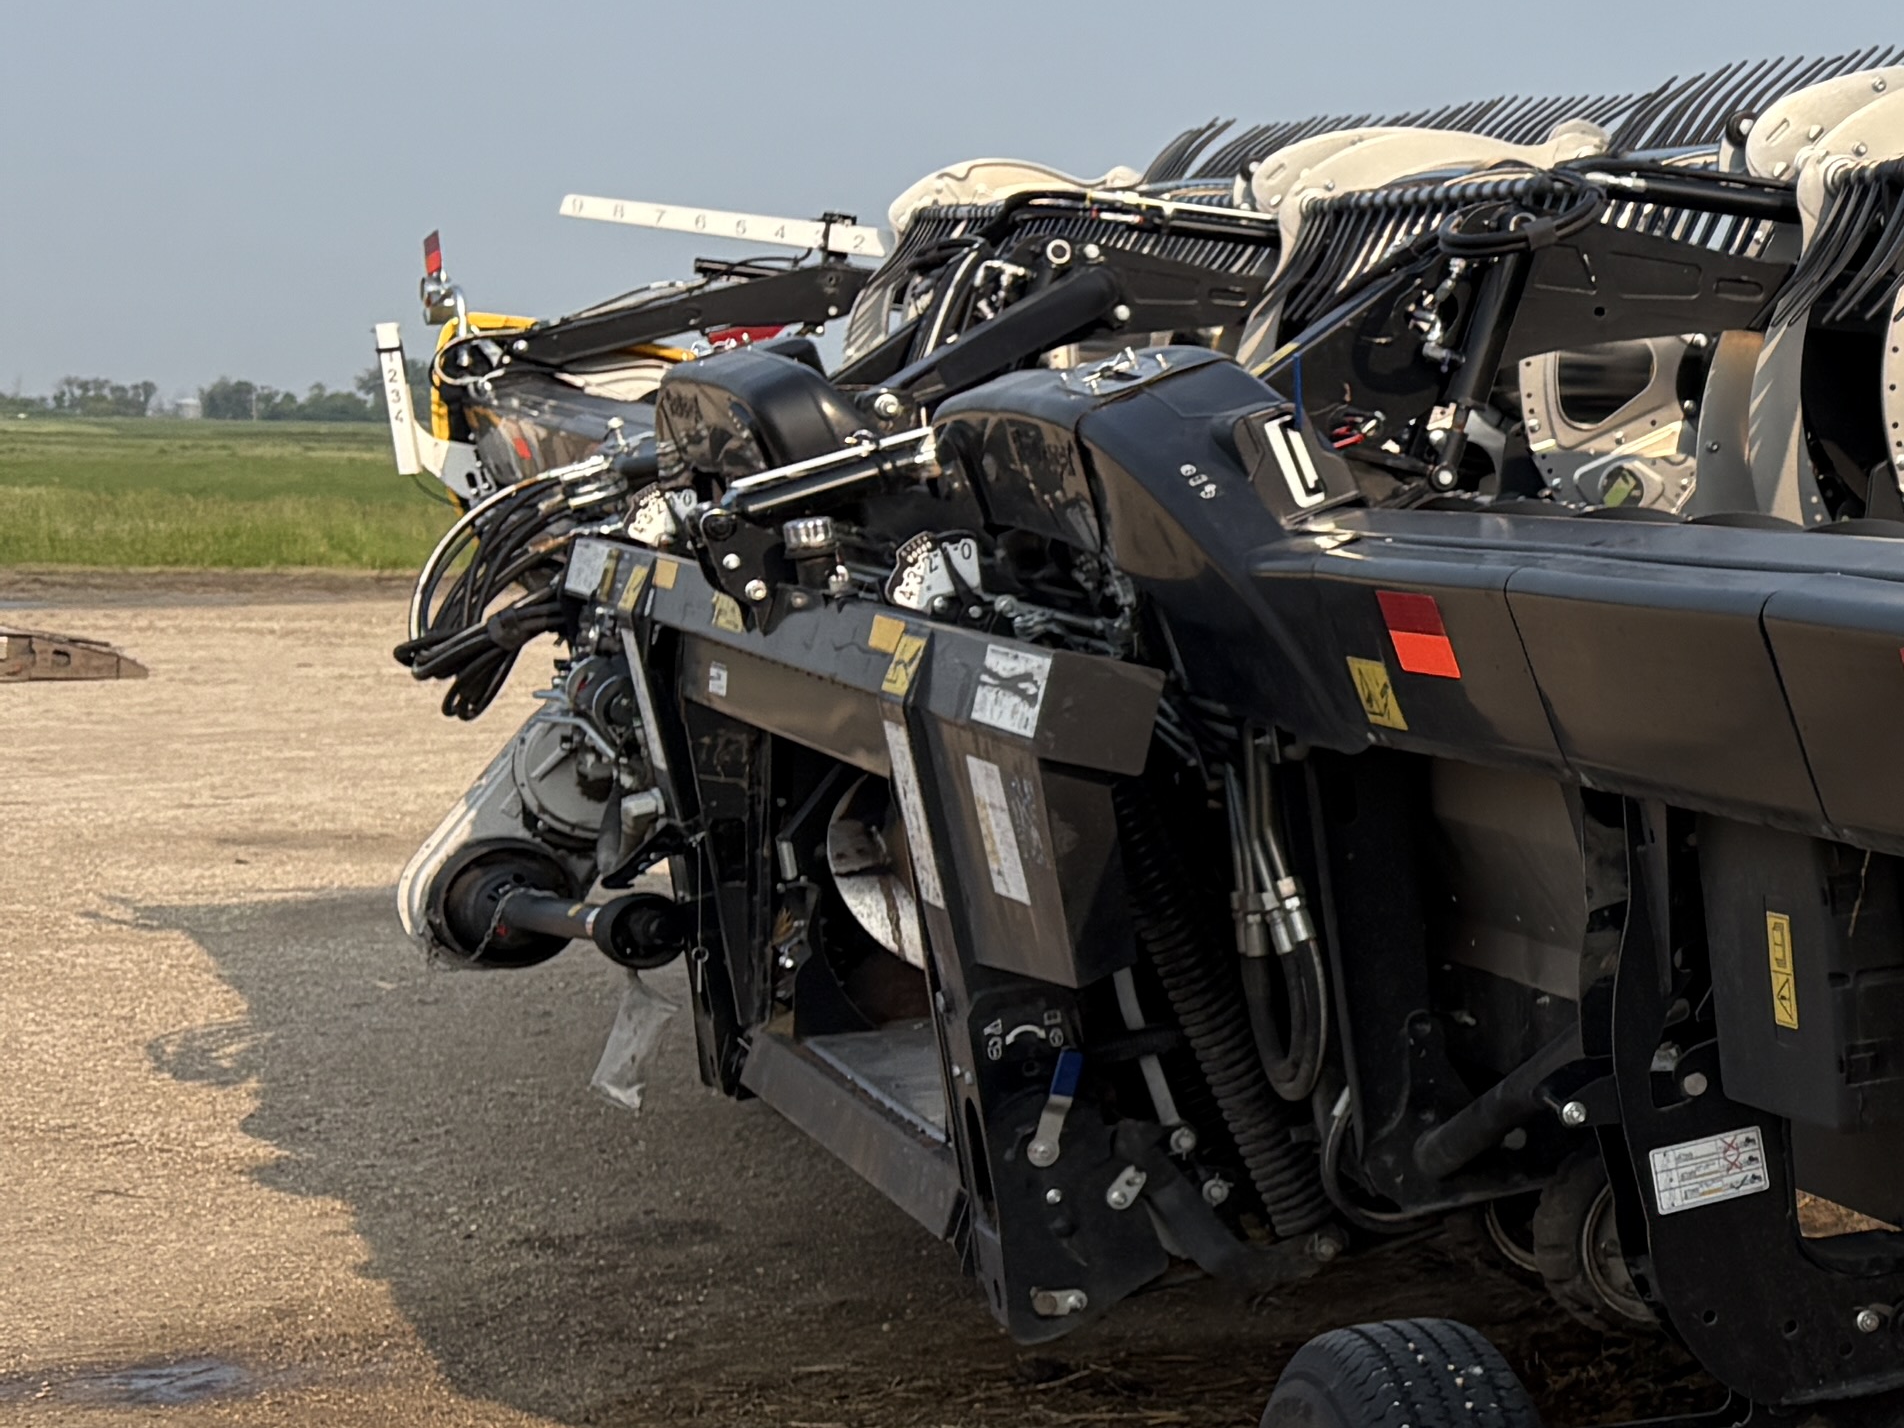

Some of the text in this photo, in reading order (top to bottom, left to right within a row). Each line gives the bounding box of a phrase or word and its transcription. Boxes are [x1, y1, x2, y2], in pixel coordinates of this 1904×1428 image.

[654, 209, 667, 225] 7
[694, 214, 706, 230] 6
[774, 224, 786, 240] 4
[852, 234, 866, 251] 2
[387, 368, 398, 383] 2
[390, 388, 401, 404] 3
[961, 541, 972, 561] 0
